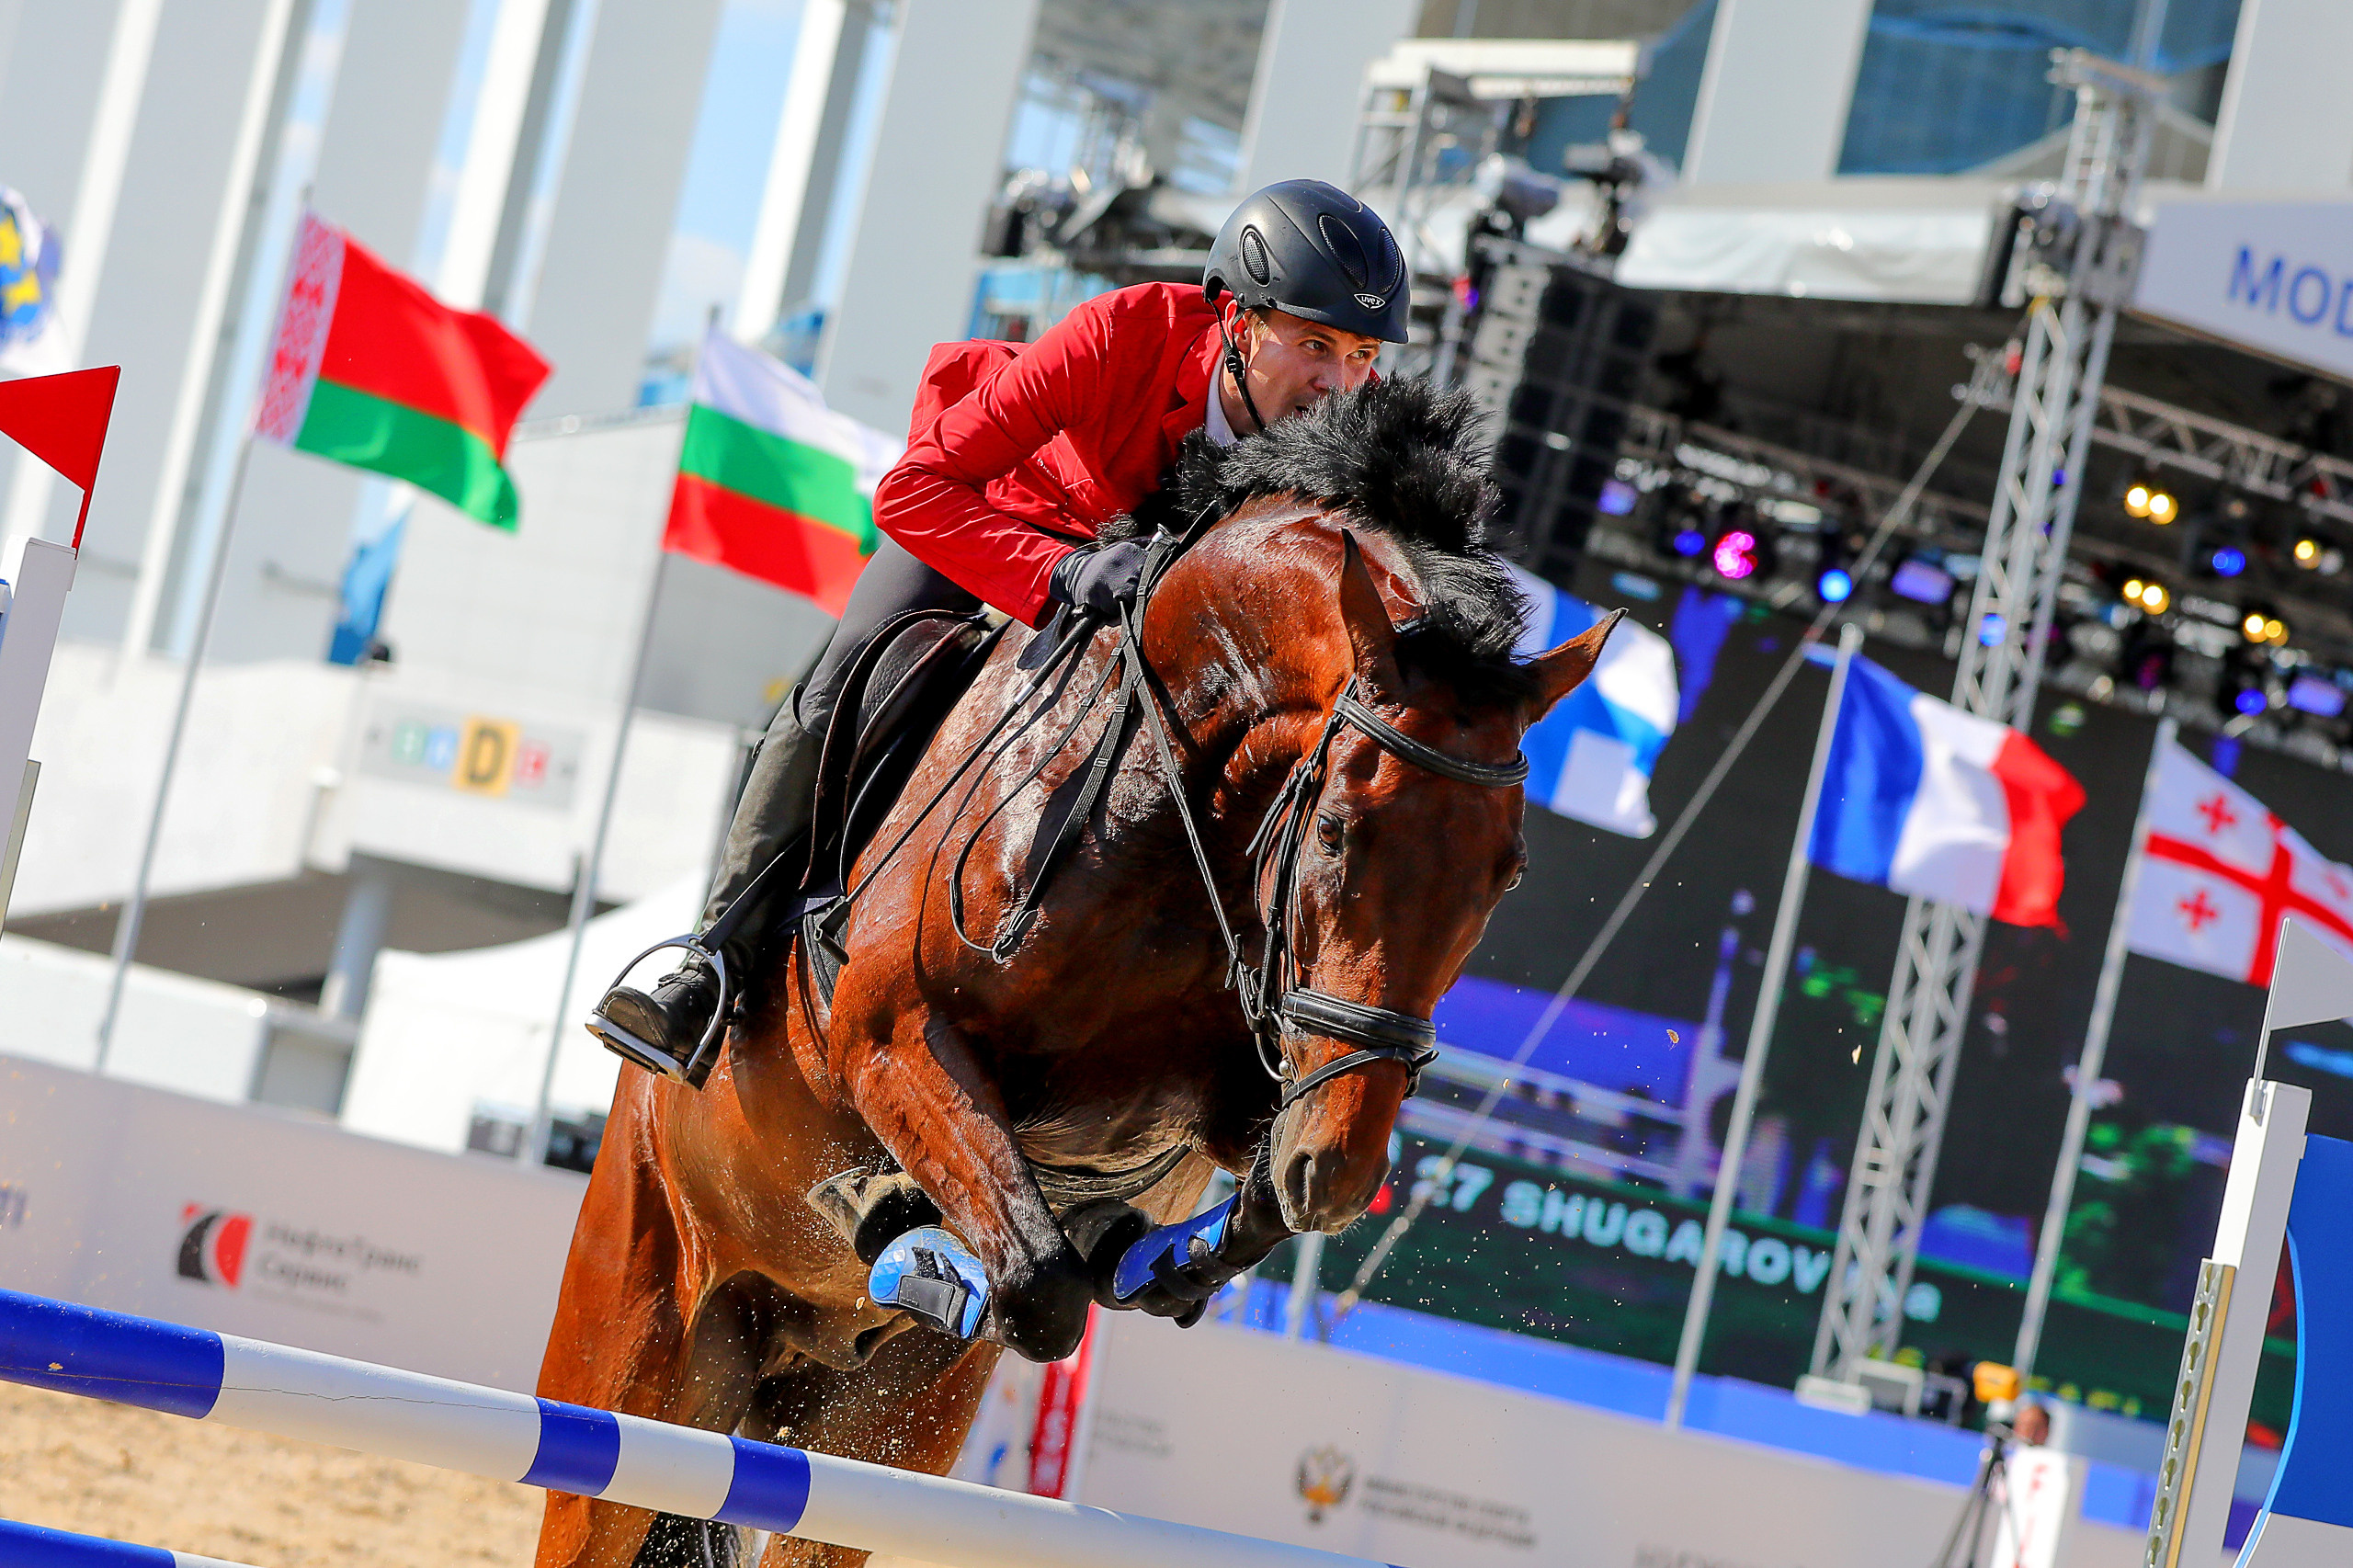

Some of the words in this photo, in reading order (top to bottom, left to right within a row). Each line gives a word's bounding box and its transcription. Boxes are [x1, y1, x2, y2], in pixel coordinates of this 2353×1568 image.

[1361, 295, 1381, 306] uvex
[465, 722, 506, 784] D
[1411, 1154, 1495, 1212] 27
[1500, 1179, 1832, 1294] SHUGAROV
